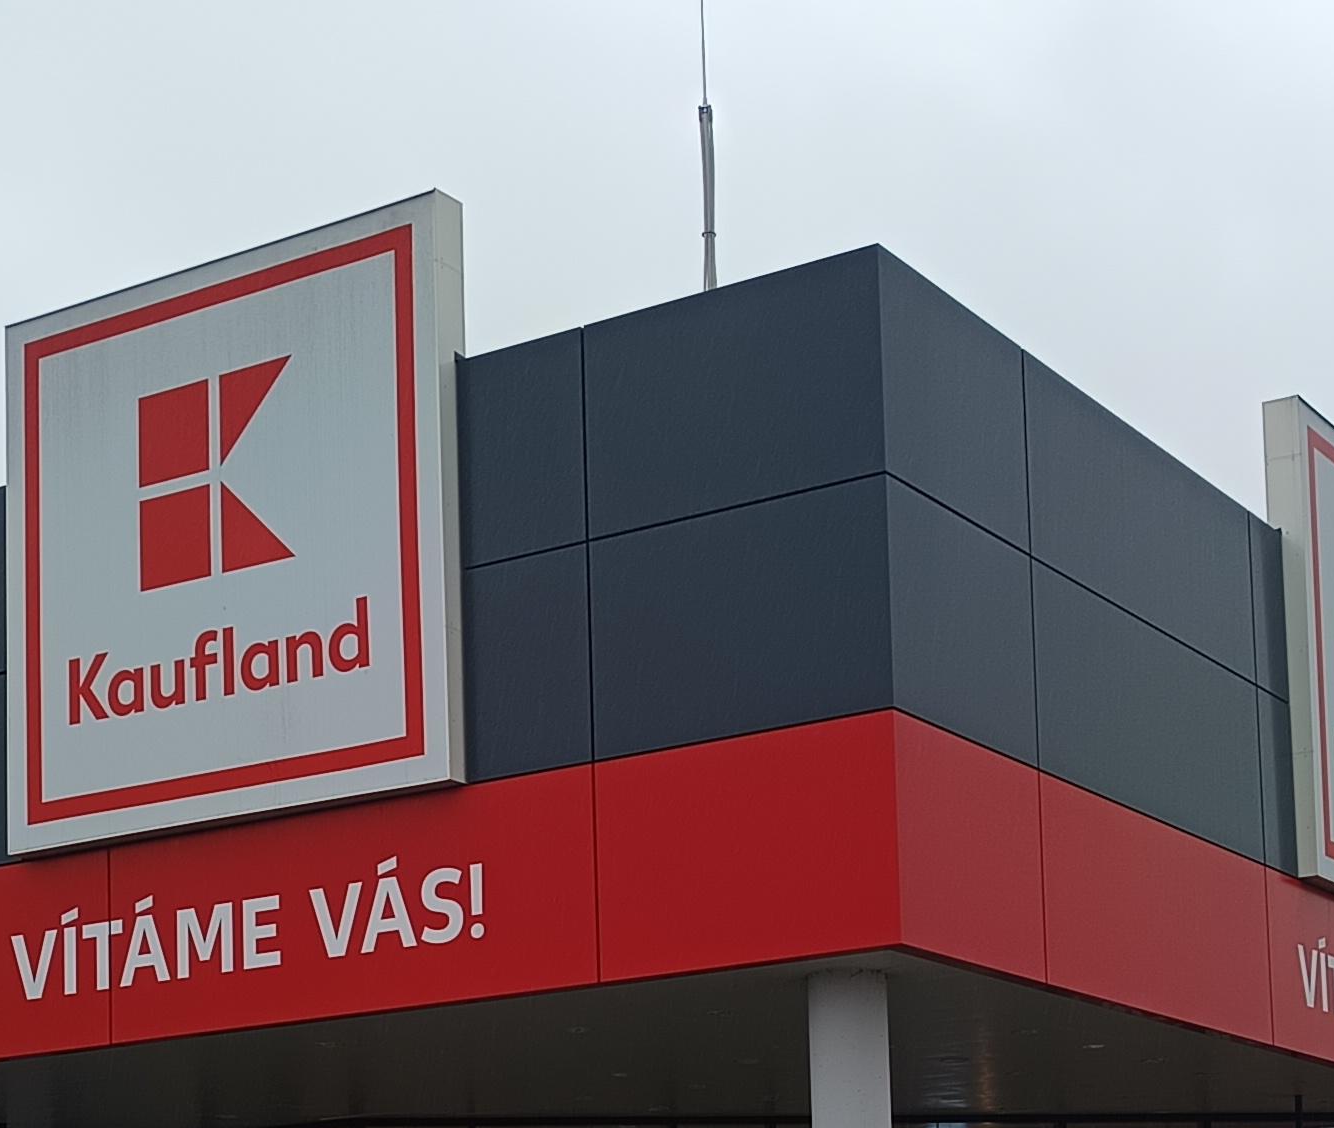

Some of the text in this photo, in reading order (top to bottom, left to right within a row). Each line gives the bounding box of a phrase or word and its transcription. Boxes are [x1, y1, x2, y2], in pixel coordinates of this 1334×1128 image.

[68, 596, 370, 725] Kaufland
[11, 856, 485, 1000] VÍTÁME VÁS!
